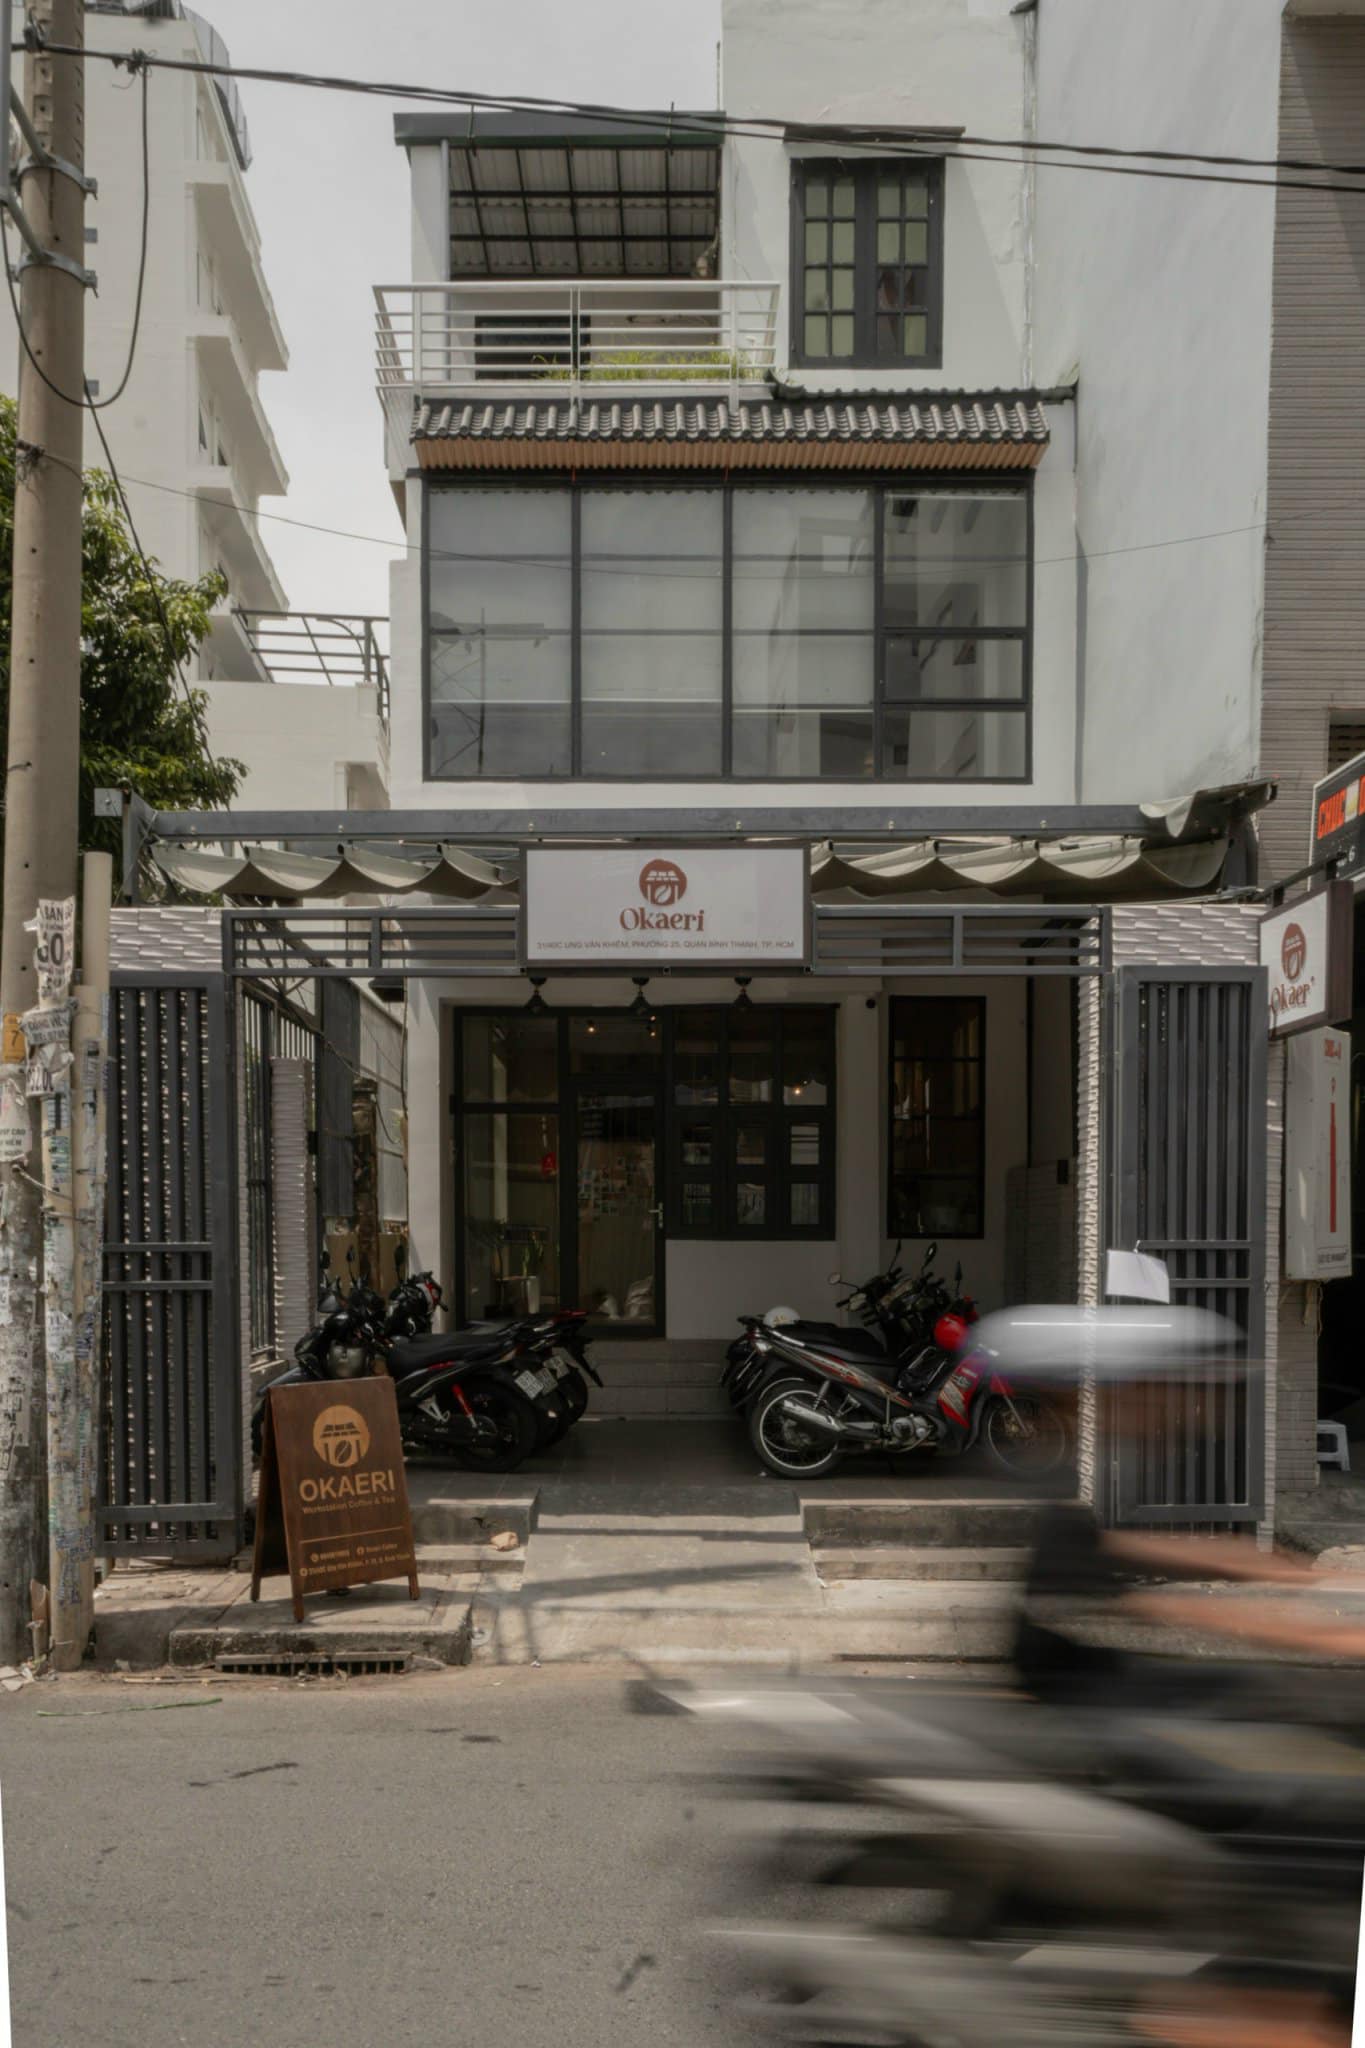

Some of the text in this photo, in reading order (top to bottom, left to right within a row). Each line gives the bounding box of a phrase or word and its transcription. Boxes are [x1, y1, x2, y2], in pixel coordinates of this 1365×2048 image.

[619, 906, 705, 932] Okaeri
[1271, 975, 1315, 1013] Okaer
[299, 1469, 396, 1502] OKAERI
